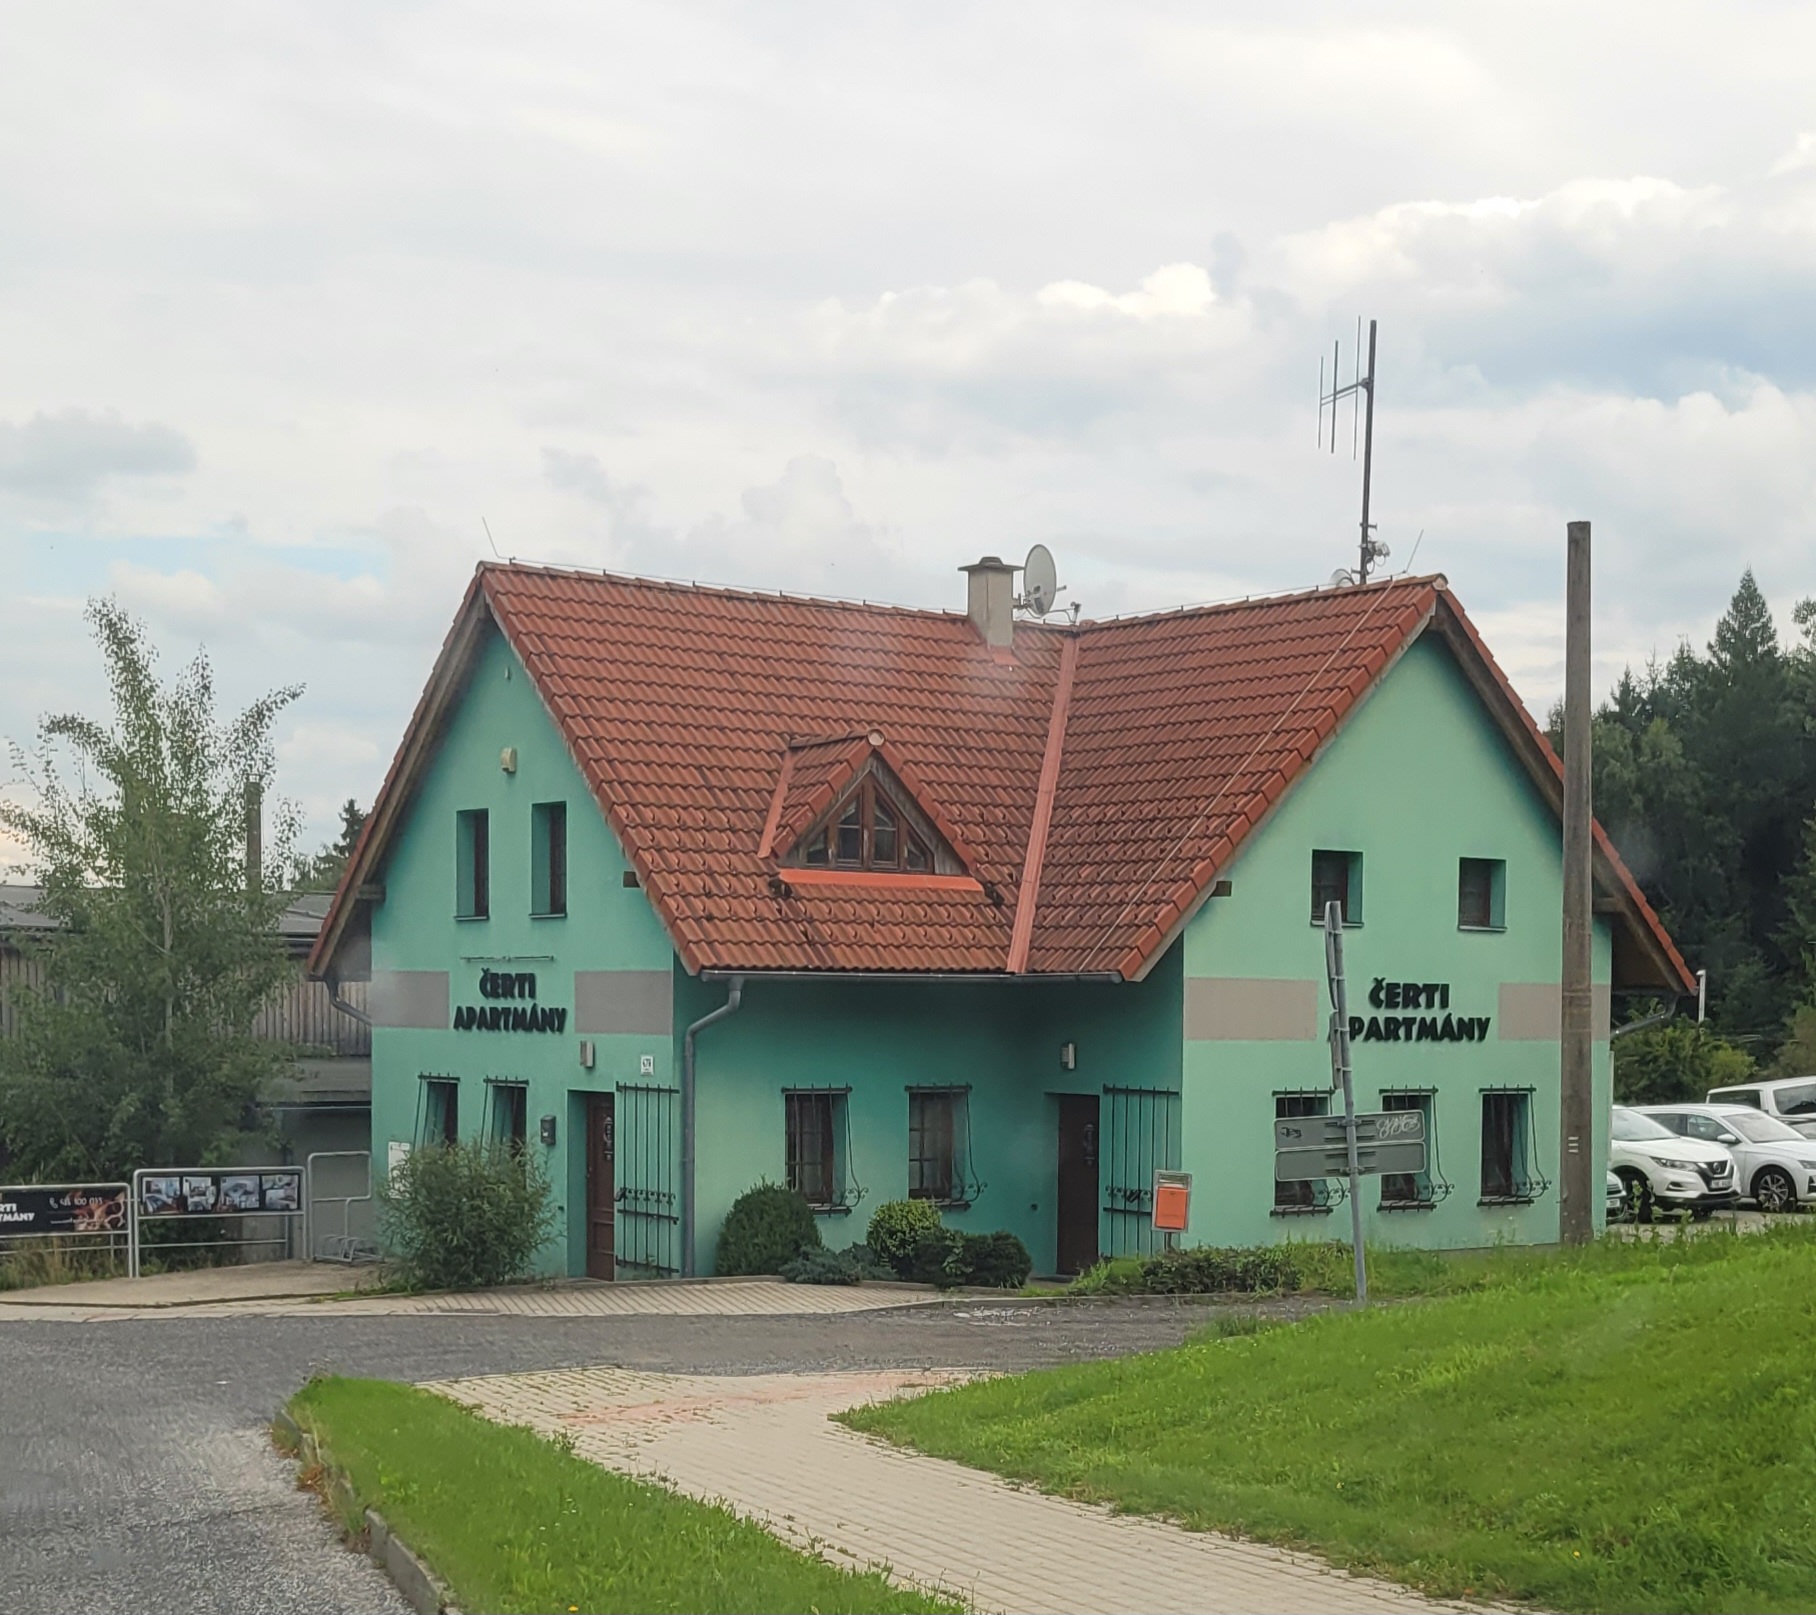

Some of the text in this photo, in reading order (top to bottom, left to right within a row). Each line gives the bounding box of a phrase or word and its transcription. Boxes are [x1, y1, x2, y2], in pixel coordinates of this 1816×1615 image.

[479, 967, 537, 1000] ČERTI
[1368, 977, 1450, 1010] ČERTI
[453, 1002, 567, 1034] APARTMÁNY
[1328, 1012, 1491, 1042] PARTMÁNY
